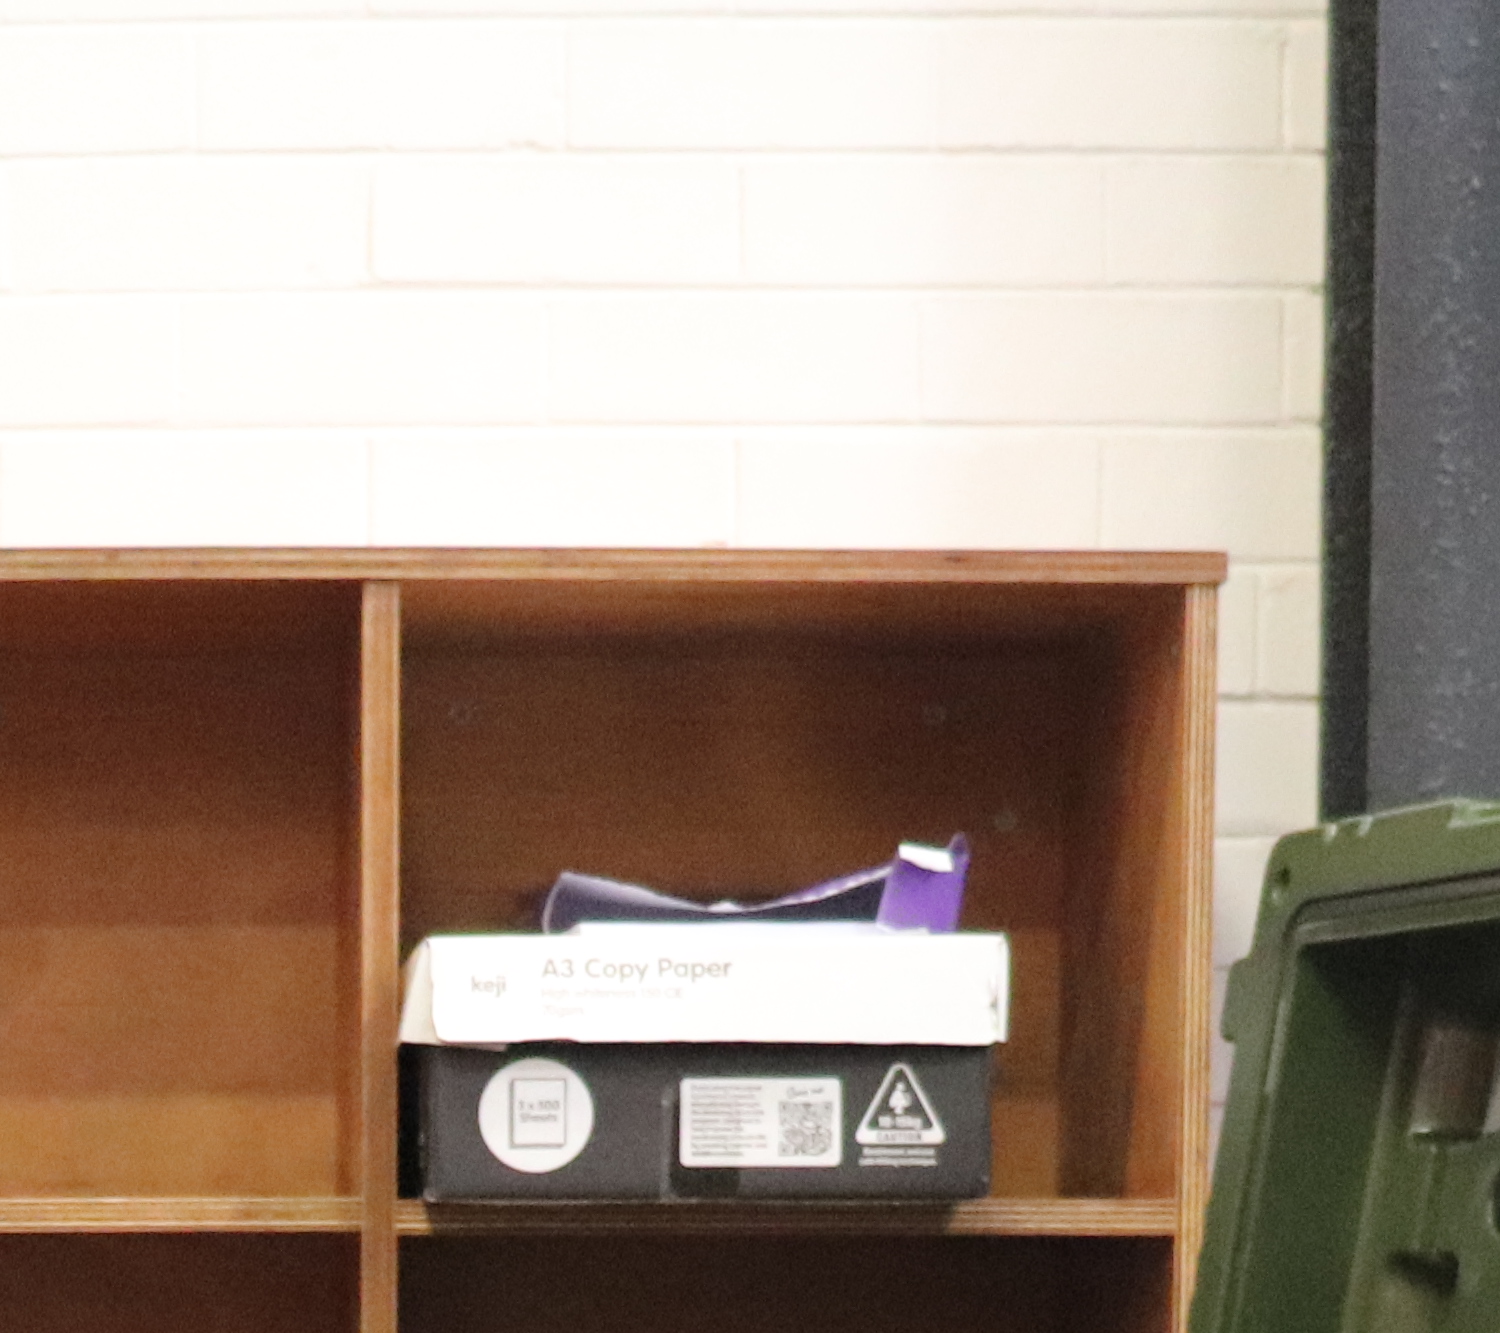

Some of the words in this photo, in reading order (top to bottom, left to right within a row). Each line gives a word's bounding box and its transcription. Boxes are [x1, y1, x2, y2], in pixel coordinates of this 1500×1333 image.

[541, 958, 575, 978] A3
[584, 958, 649, 983] Copy
[657, 958, 733, 983] Paper
[470, 975, 507, 998] keji
